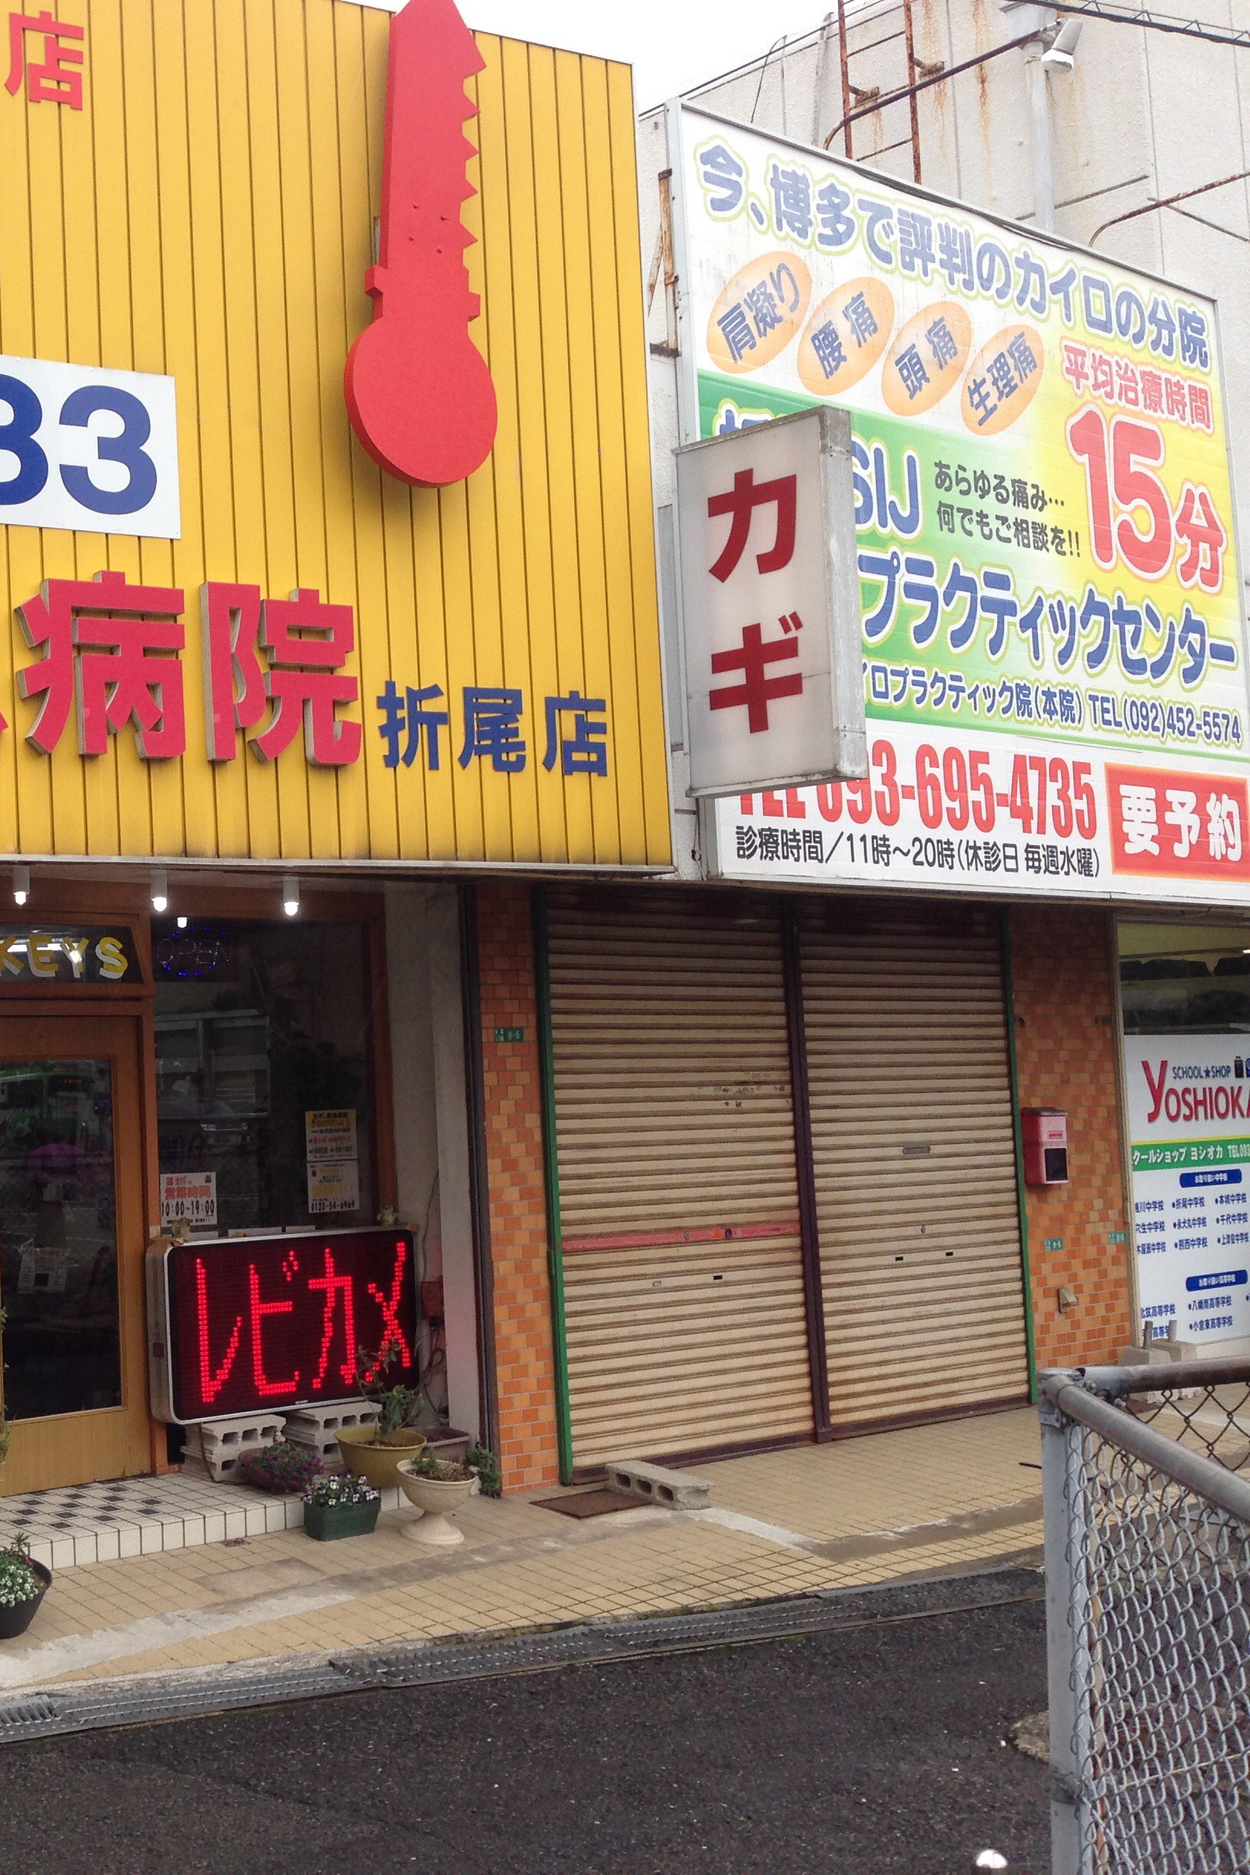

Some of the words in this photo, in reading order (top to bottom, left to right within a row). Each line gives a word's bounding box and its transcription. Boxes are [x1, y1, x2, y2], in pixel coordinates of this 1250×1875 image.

[699, 144, 1209, 369] 今、博多で評判のカイロの分院
[716, 262, 800, 365] 肩凝り
[967, 330, 1038, 427] 生理痛
[1063, 344, 1211, 430] 平均治療時間
[1069, 409, 1224, 588] 15分
[707, 467, 804, 734] カギ
[857, 550, 1236, 684] プラクティックセンター
[375, 680, 610, 778] 折尾店
[862, 662, 1083, 725] ロプラクティック院(本院)
[1088, 693, 1241, 744] TEL(092)452-5574
[1119, 784, 1242, 862] 要予約
[1141, 1060, 1250, 1124] YOSHIOK
[1132, 1147, 1187, 1166] クールショップ
[1190, 1144, 1224, 1161] ヨシオカ
